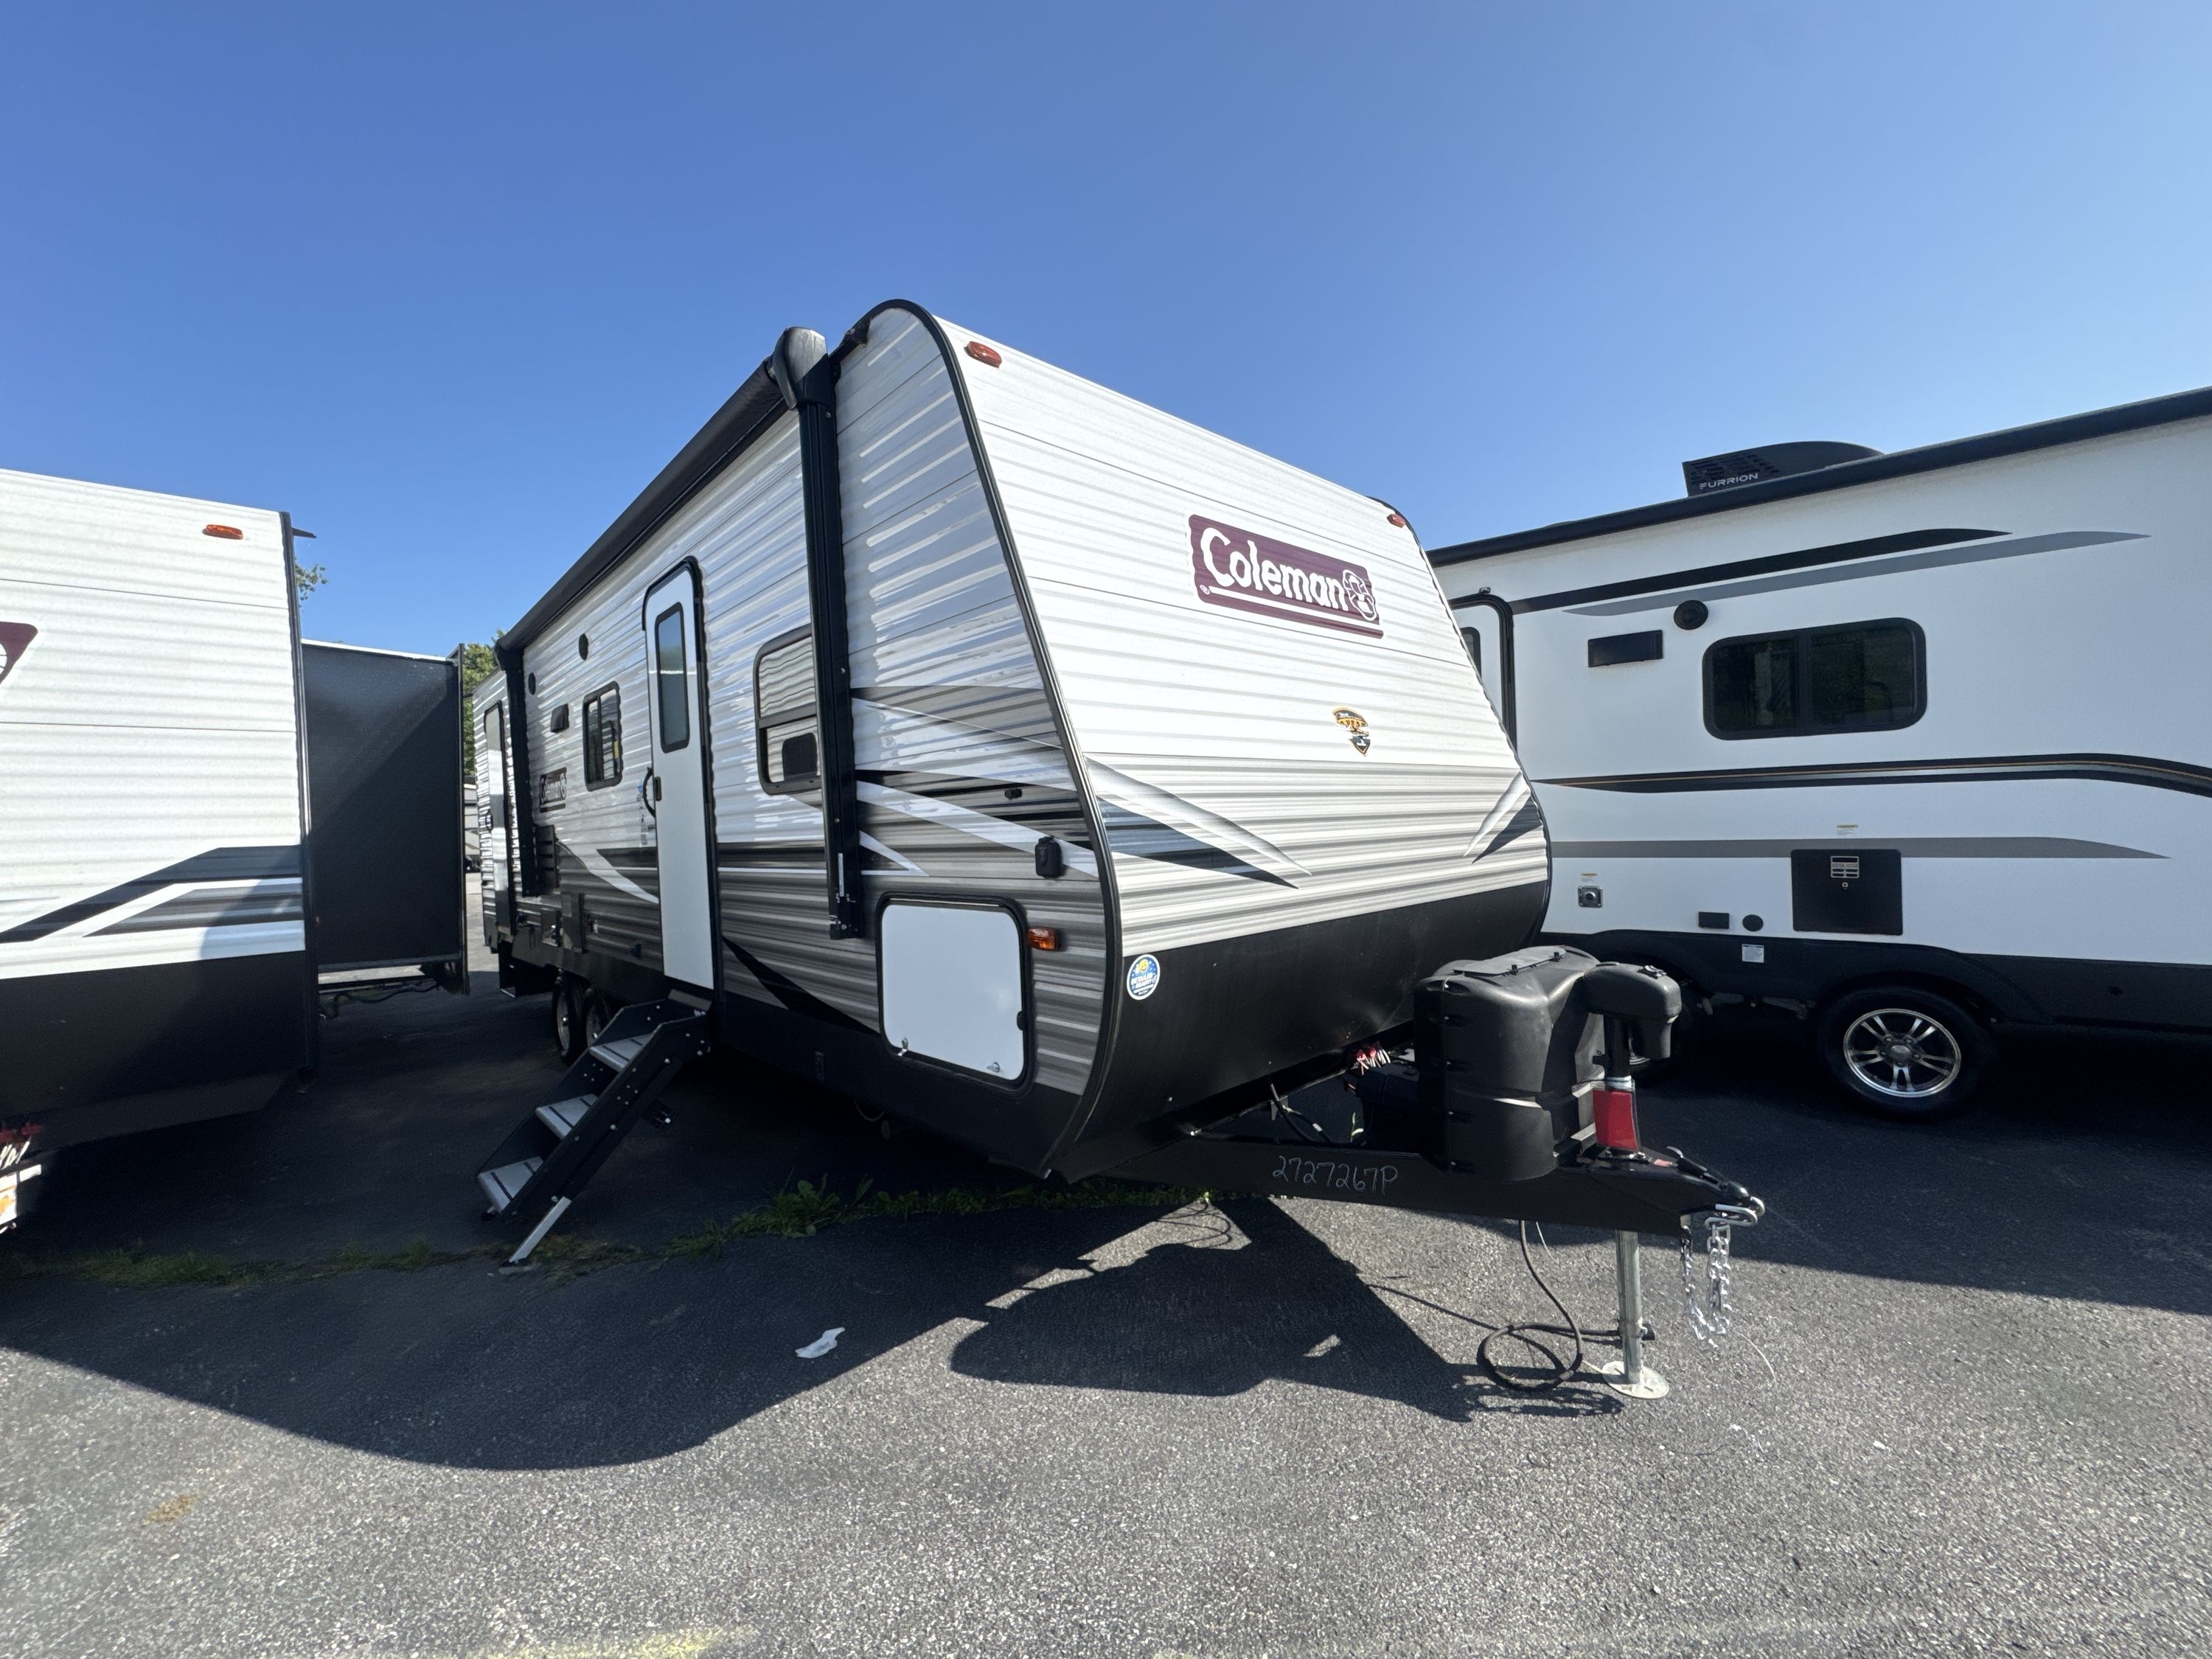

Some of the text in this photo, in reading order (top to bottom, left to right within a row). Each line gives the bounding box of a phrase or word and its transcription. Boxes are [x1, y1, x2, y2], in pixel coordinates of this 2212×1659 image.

[1699, 472, 1759, 490] FURRION
[1200, 527, 1349, 612] Coleman
[1272, 1155, 1399, 1196] 2727267P
